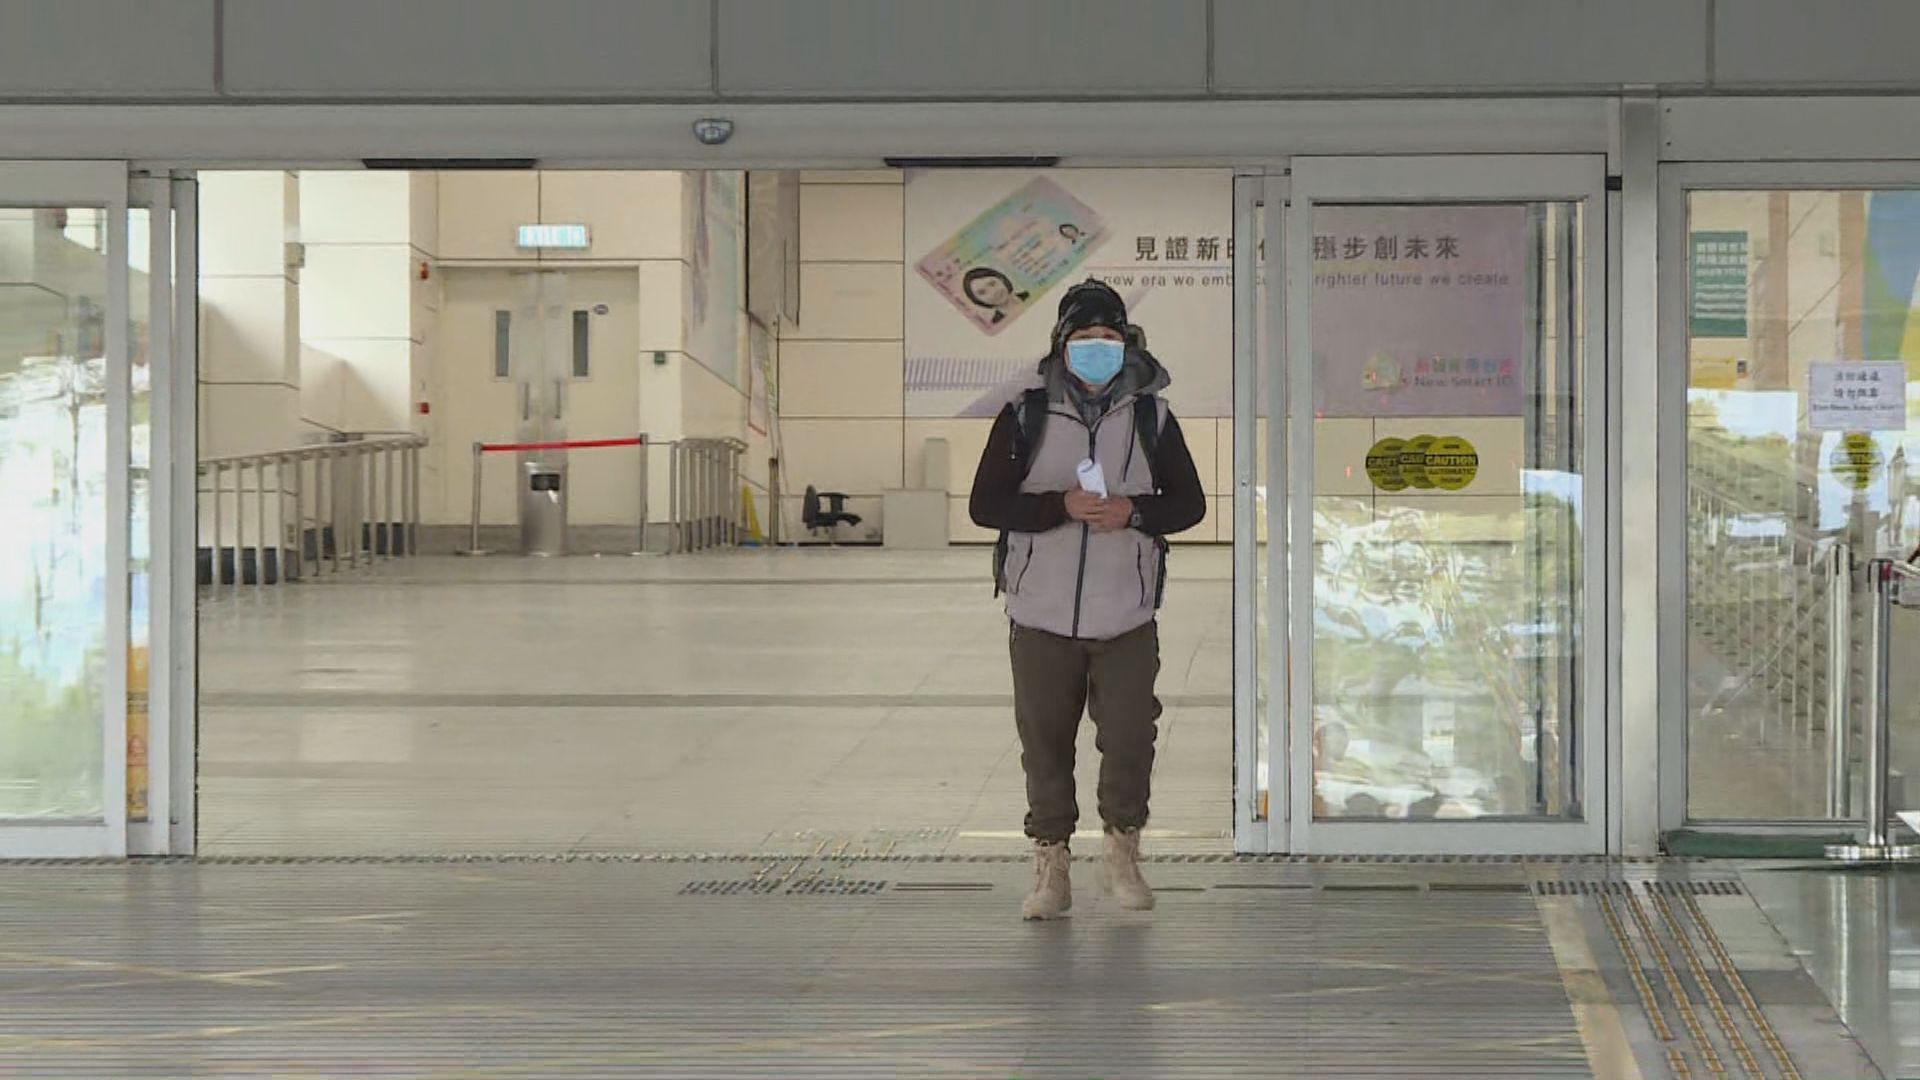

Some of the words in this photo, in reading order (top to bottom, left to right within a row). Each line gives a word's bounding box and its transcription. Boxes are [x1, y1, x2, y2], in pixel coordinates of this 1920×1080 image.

[1141, 276, 1166, 287] era
[1173, 276, 1194, 287] we
[1313, 272, 1367, 288] righter
[1375, 272, 1423, 286] future
[1429, 275, 1451, 286] we
[1458, 273, 1509, 286] create
[1425, 455, 1477, 466] CAUTION
